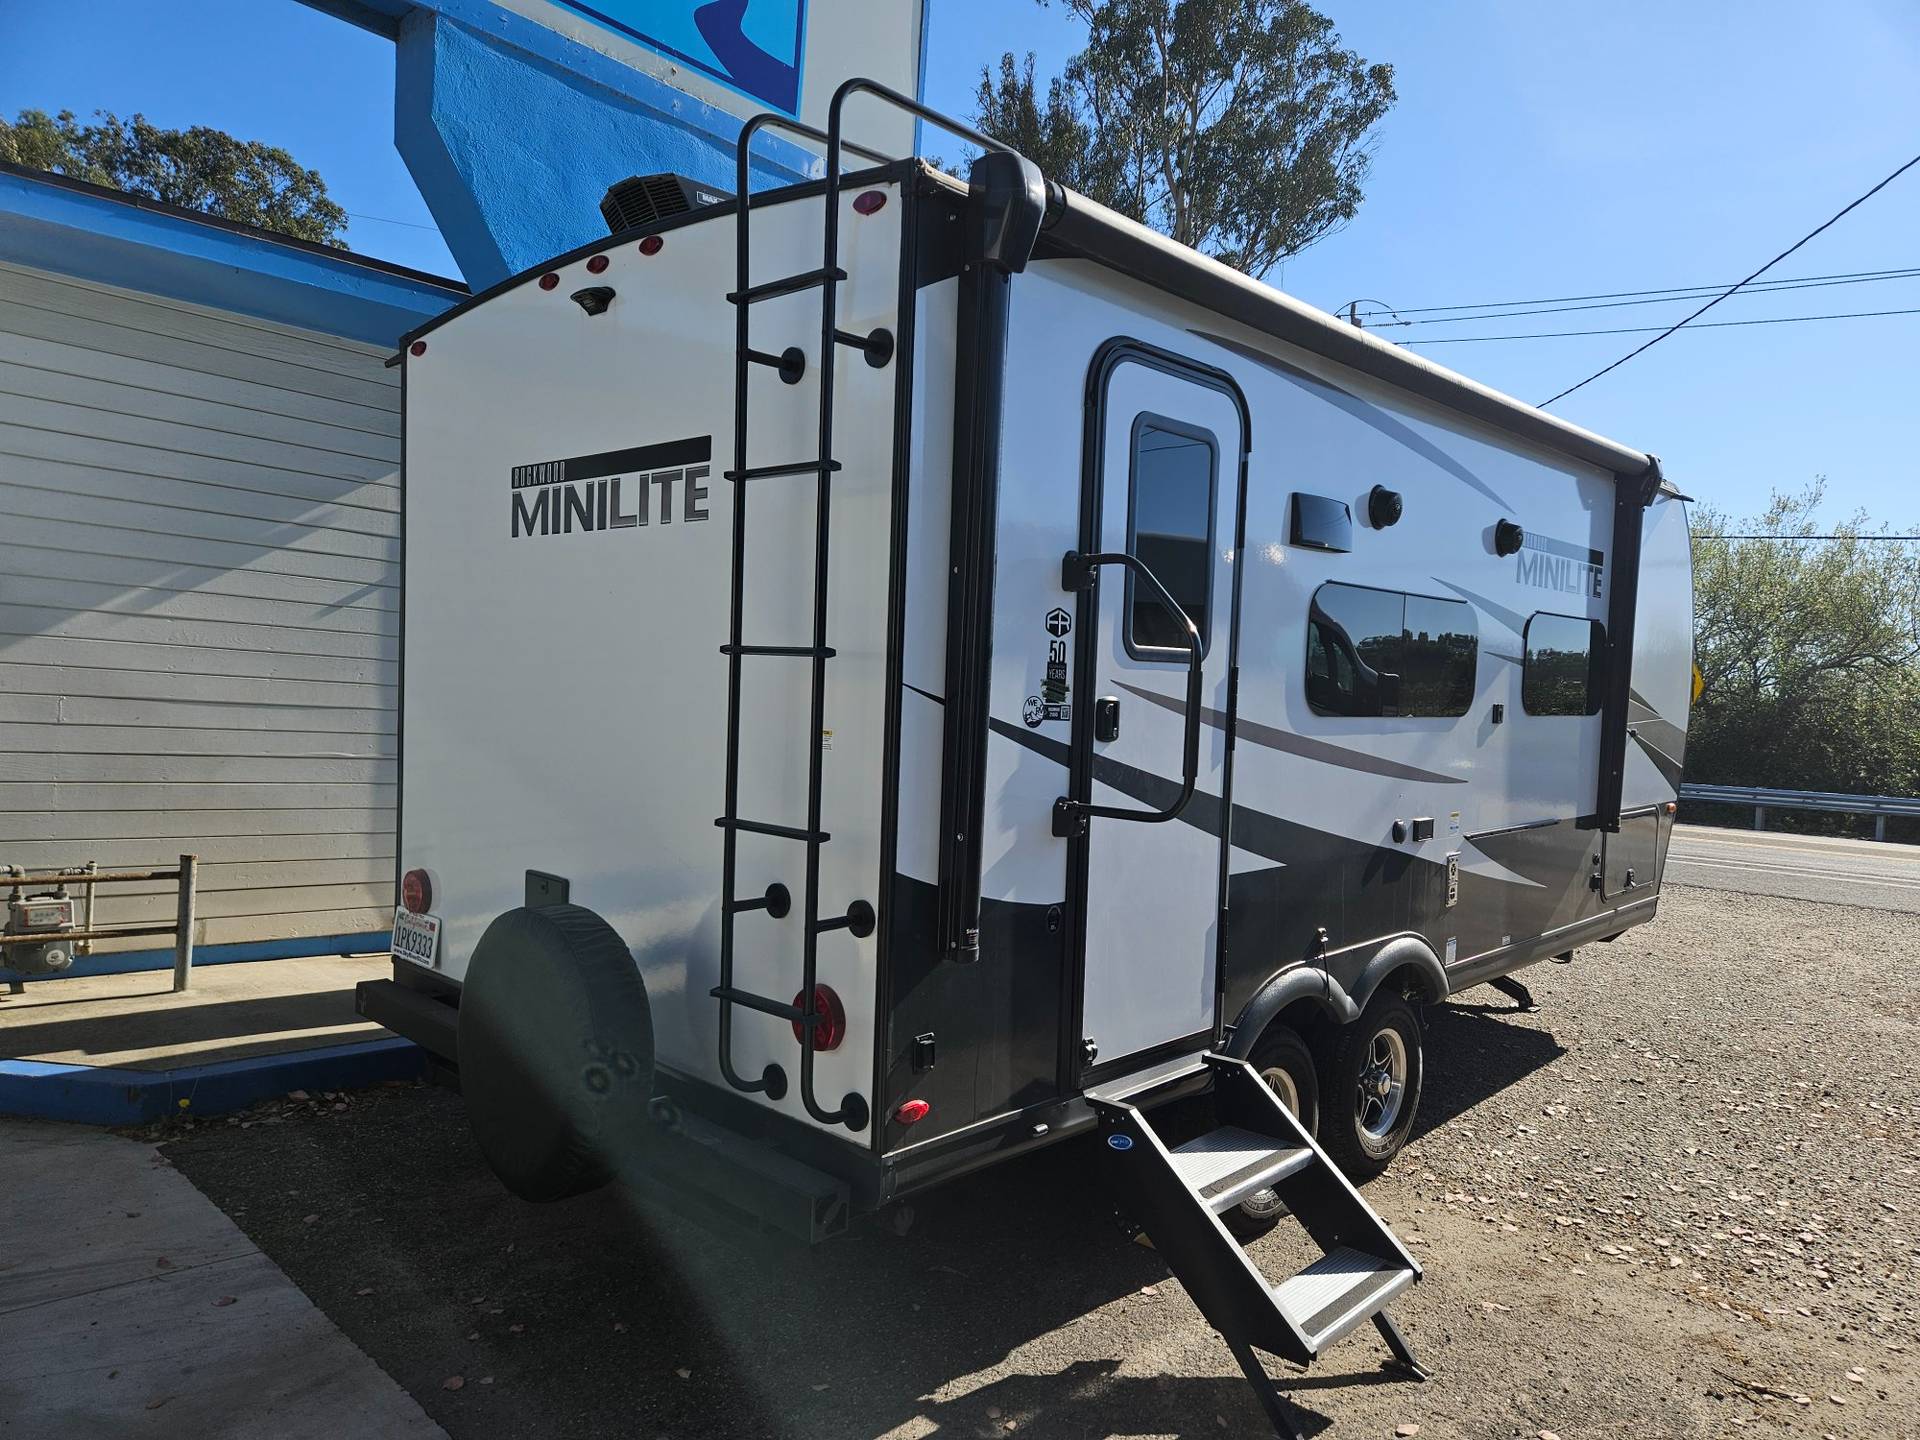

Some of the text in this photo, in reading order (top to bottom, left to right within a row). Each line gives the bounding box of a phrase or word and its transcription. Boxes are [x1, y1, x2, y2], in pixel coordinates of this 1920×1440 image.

[514, 461, 566, 488] ROCKWOOD
[511, 465, 710, 538] MINILITE
[1516, 548, 1603, 599] MINILITE
[1049, 640, 1066, 663] 50
[1048, 668, 1066, 680] YEARS
[1027, 699, 1038, 707] WE
[395, 926, 433, 959] 1PK9333
